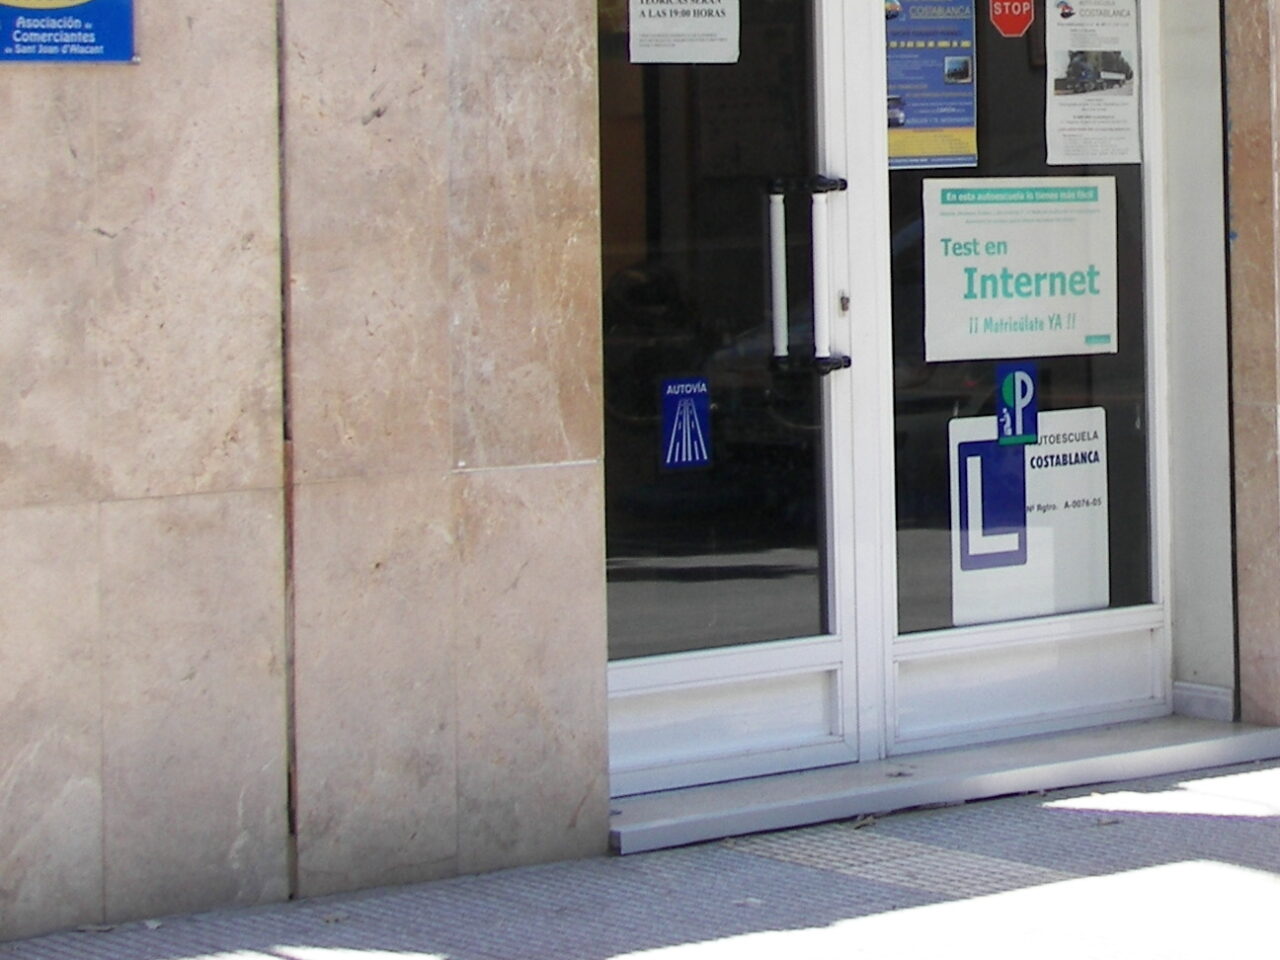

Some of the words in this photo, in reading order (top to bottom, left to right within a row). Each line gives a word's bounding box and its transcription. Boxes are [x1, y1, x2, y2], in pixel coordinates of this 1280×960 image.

[640, 9, 646, 18] A
[648, 9, 667, 18] LAS
[693, 9, 726, 18] HORAS
[993, 1, 1030, 16] STOP
[16, 16, 82, 29] Asociación
[12, 30, 96, 43] Comerciantes
[940, 238, 980, 257] Test
[985, 241, 1007, 255] en
[964, 264, 1100, 300] Internet
[1048, 314, 1062, 330] YA
[666, 380, 707, 394] AUTOVÍA
[1037, 430, 1099, 446] UTOESCUELA
[1030, 450, 1100, 470] COSTABLANCA
[967, 456, 1019, 556] L
